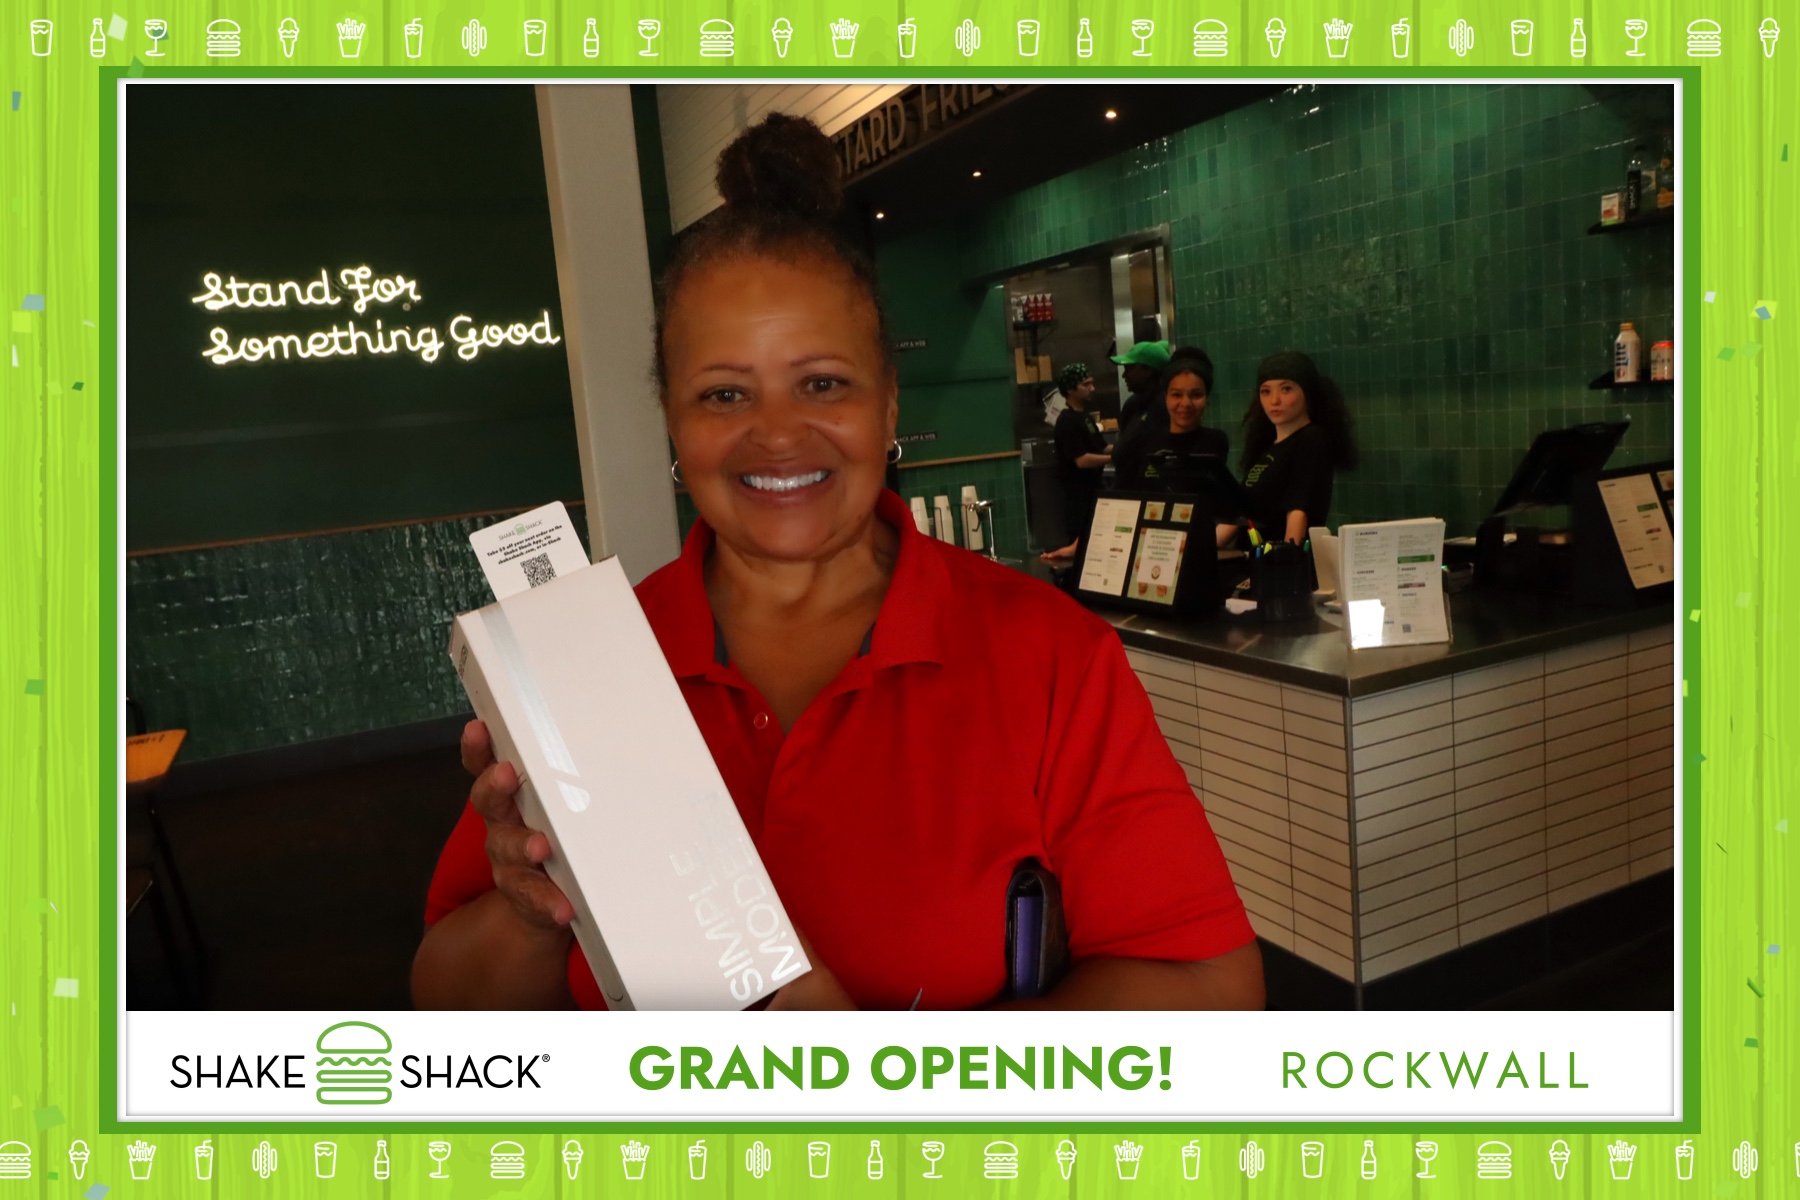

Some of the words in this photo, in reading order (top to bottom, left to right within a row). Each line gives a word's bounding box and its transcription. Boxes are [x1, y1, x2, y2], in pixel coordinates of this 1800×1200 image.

[832, 94, 907, 177] TARD
[192, 266, 341, 311] Stand
[340, 265, 422, 315] For
[202, 318, 444, 364] Something
[449, 309, 561, 361] Good
[498, 530, 515, 540] SHAKE
[503, 548, 518, 556] Shake
[518, 542, 532, 550] Shack
[513, 539, 524, 547] your
[524, 534, 535, 542] next
[668, 842, 763, 1000] SIMPLE
